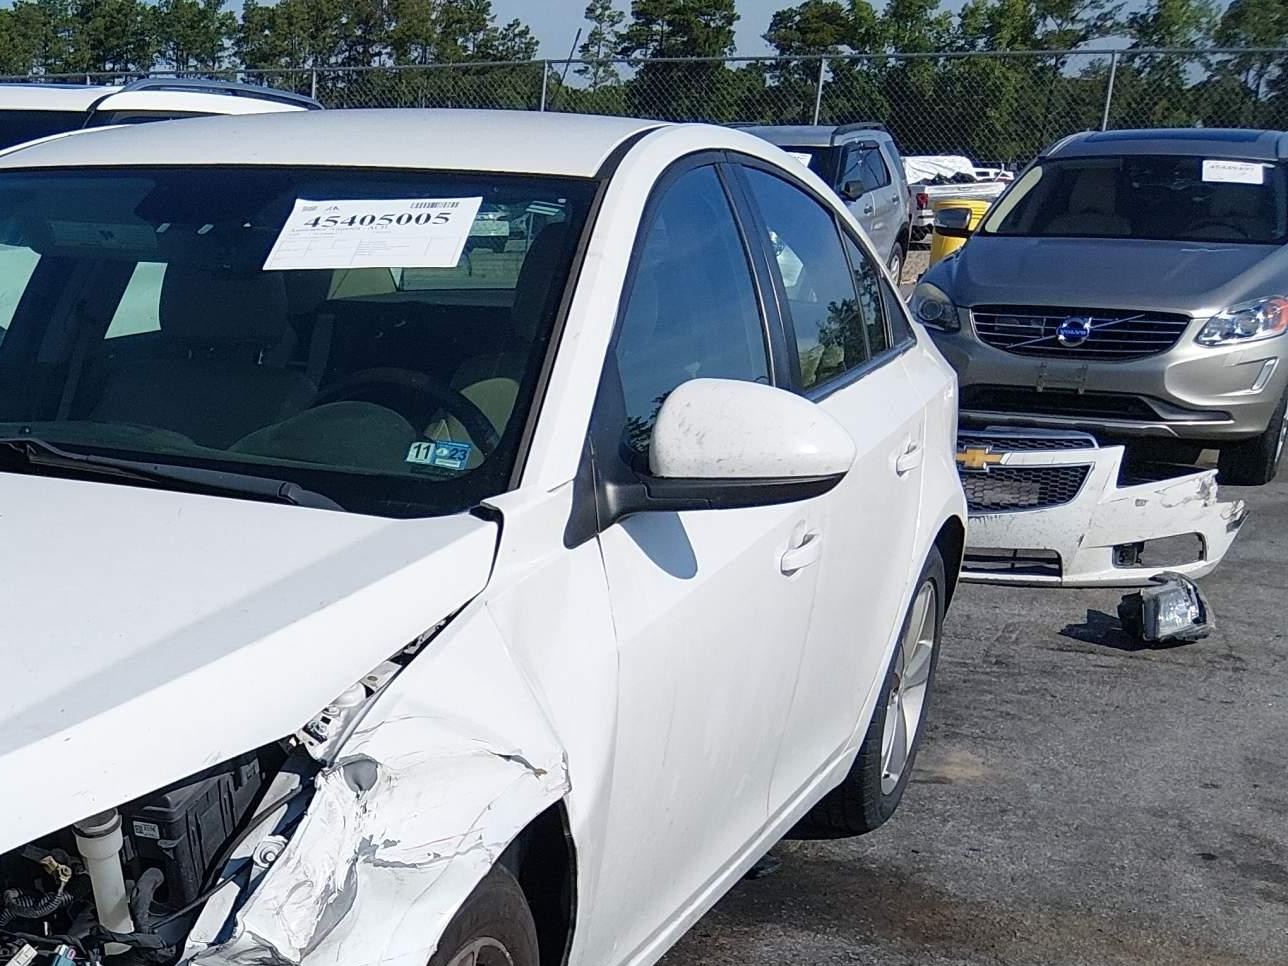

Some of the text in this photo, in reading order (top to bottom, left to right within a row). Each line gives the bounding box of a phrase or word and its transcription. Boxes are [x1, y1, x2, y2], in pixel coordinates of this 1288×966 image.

[303, 211, 453, 228] 45405005
[413, 443, 431, 460] 11
[448, 447, 468, 461] 23
